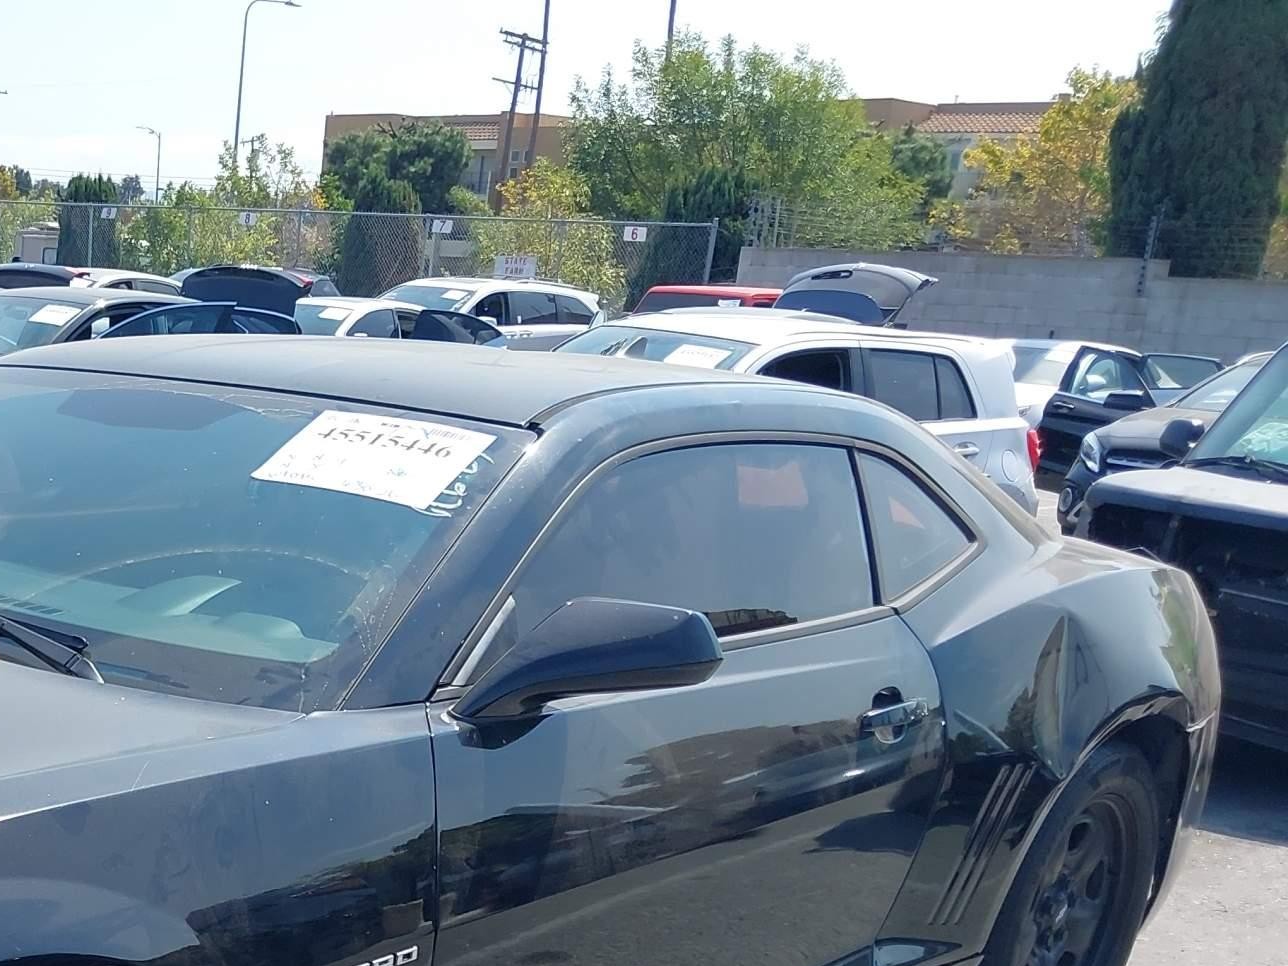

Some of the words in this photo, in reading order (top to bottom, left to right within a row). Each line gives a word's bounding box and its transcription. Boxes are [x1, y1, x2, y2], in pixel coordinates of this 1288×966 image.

[106, 207, 112, 218] 9
[244, 213, 251, 223] 8
[439, 220, 447, 232] 7
[631, 228, 638, 240] 6
[504, 257, 527, 266] STATE
[317, 427, 452, 459] 45515446
